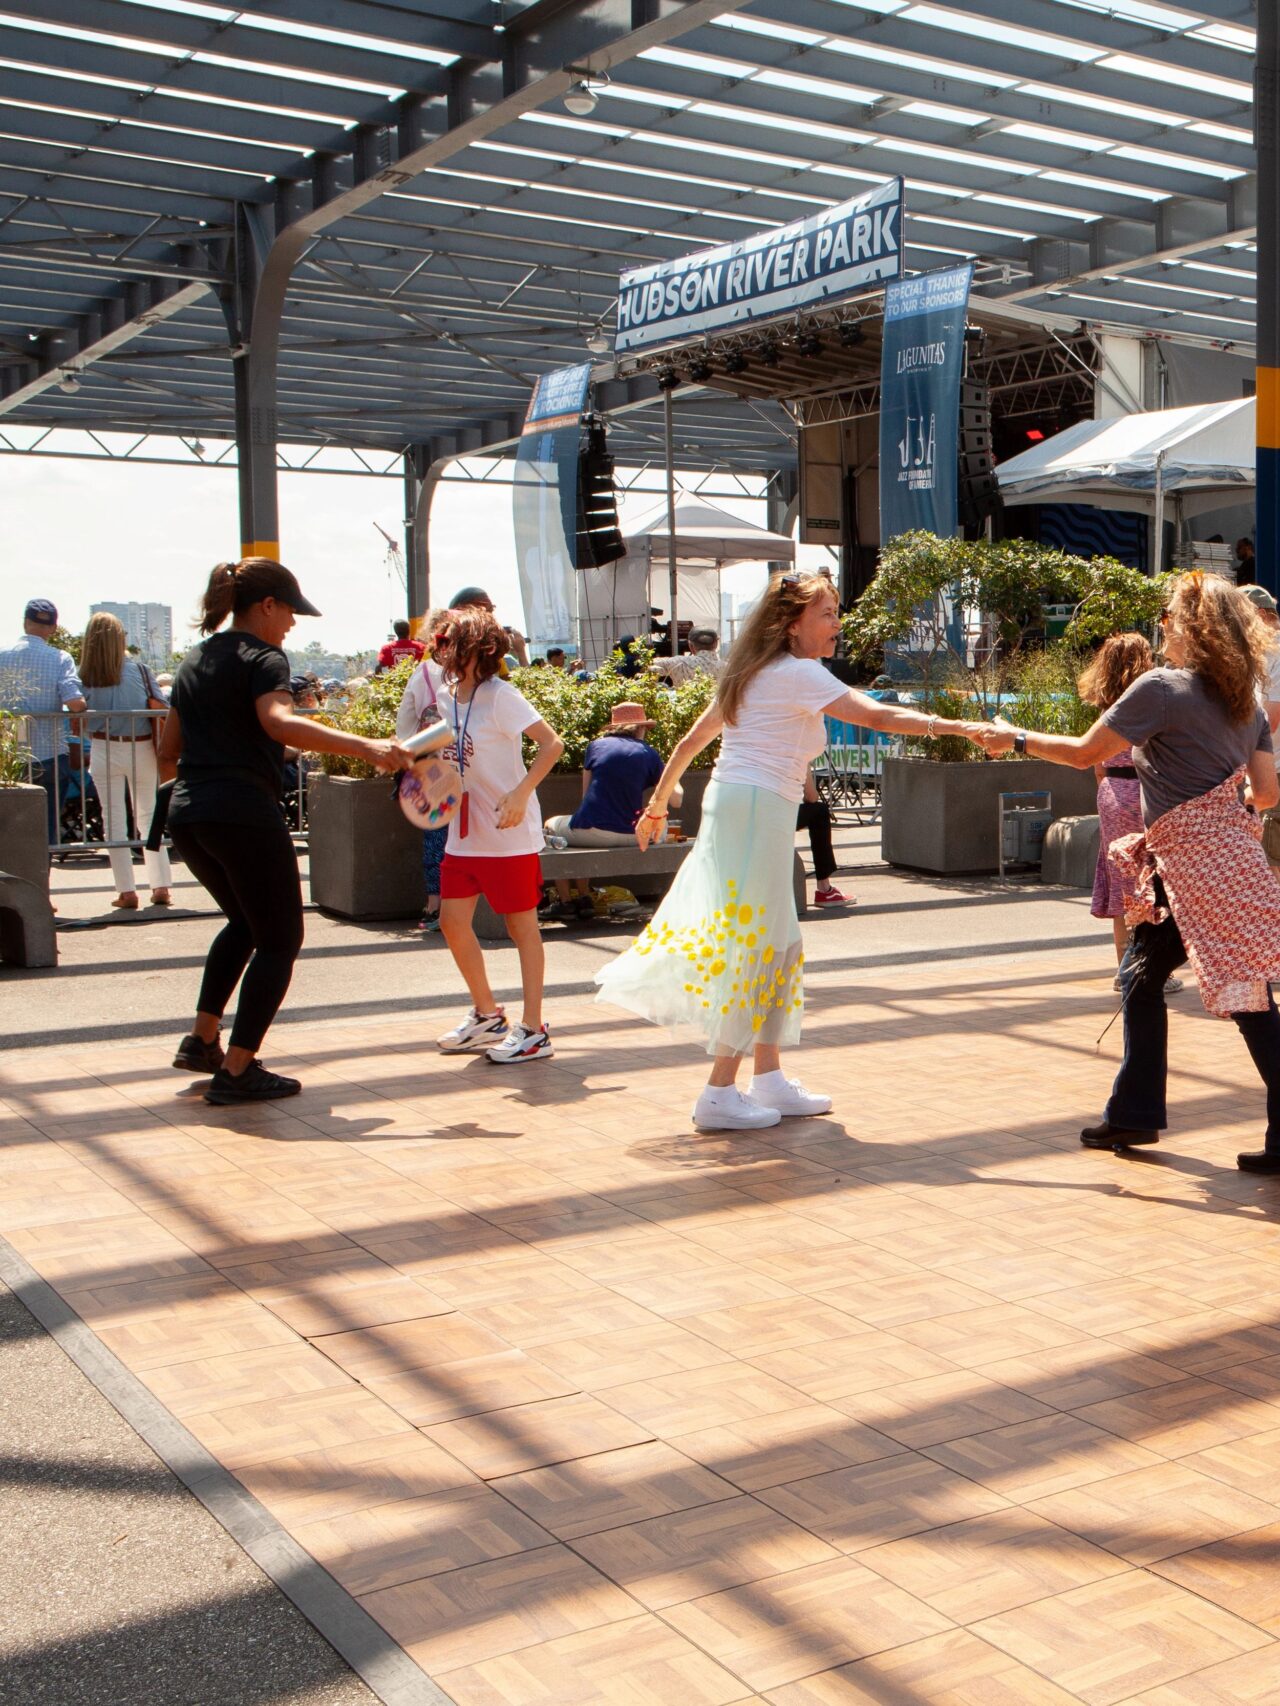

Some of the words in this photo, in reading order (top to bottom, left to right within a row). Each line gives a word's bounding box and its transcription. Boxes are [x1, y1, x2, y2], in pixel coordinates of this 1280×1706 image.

[618, 264, 723, 330] HUDSON
[726, 239, 809, 301] RIVER
[814, 205, 899, 274] PARK
[888, 281, 925, 301] SPECIAL
[927, 271, 968, 292] THANKS
[888, 303, 900, 316] TO
[901, 299, 918, 313] OUR
[919, 288, 965, 310] SPONSORS
[831, 749, 870, 768] RIVER
